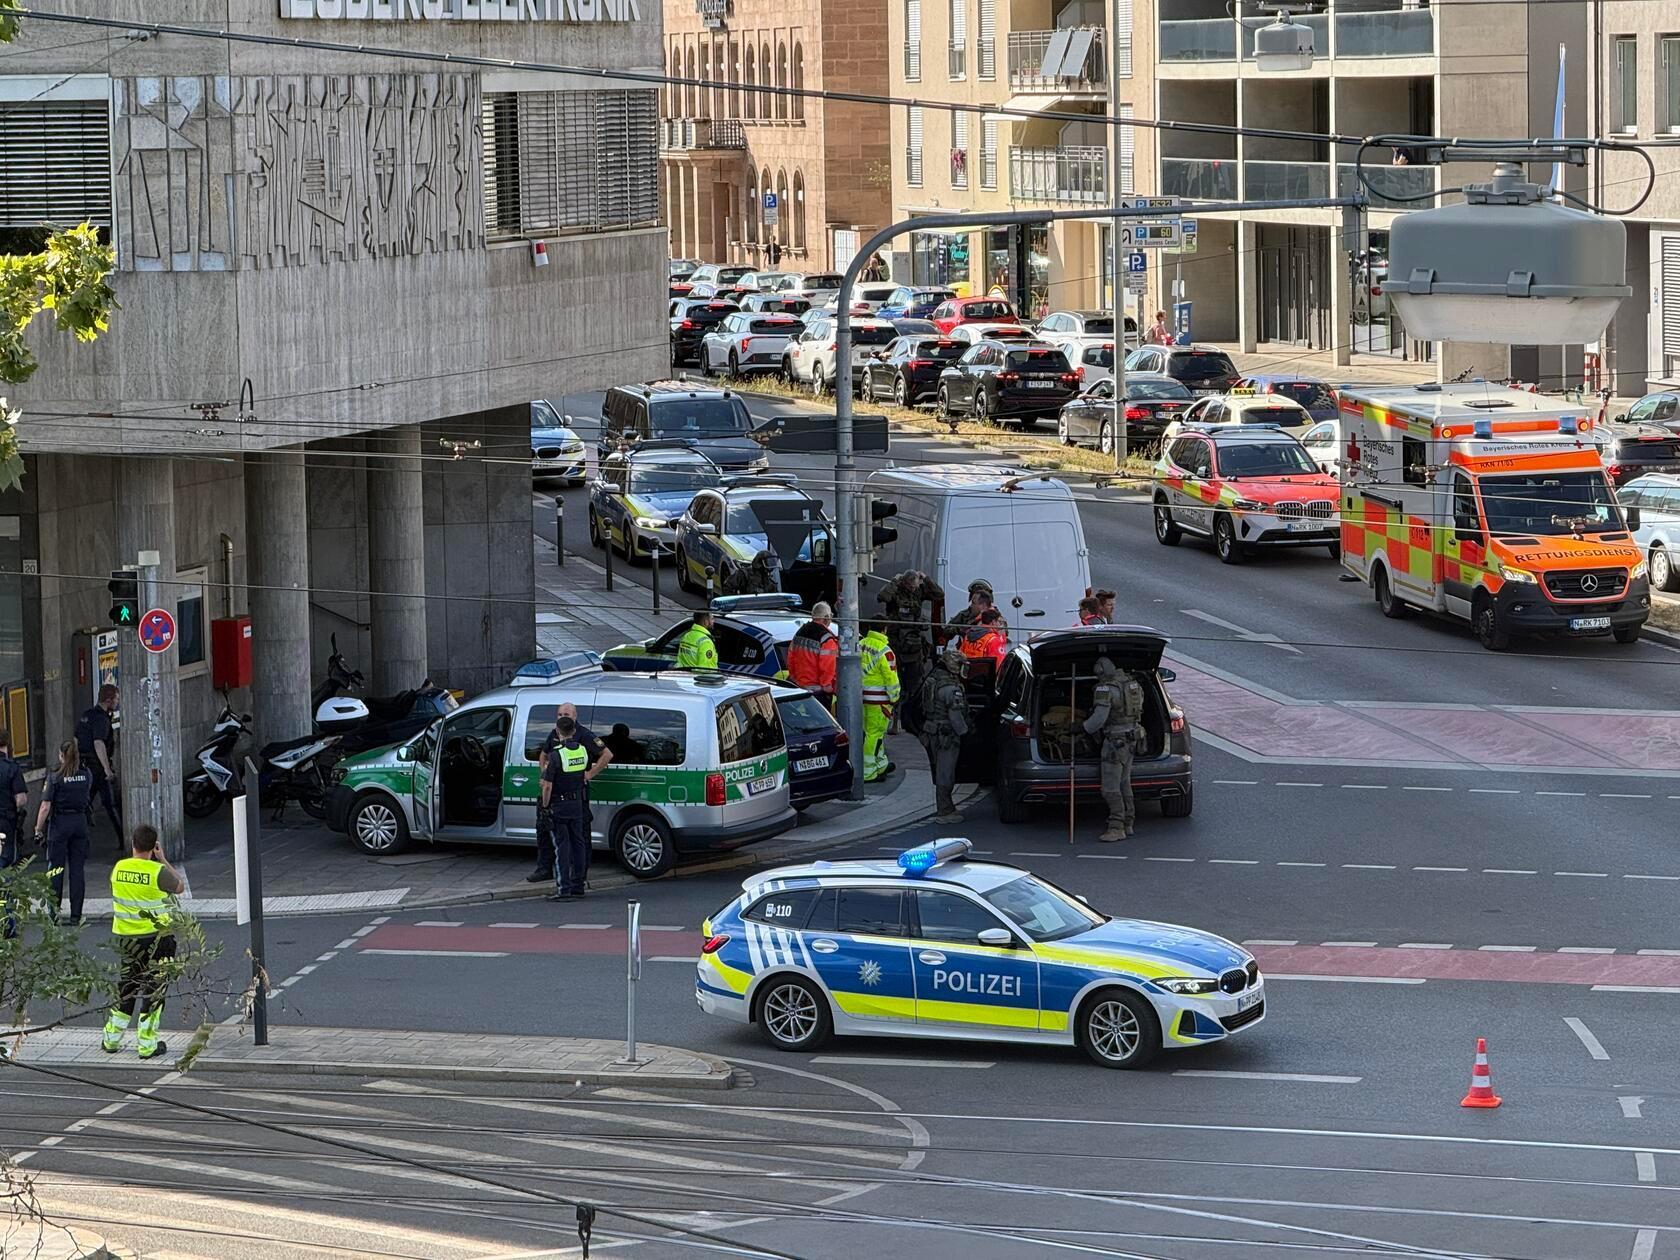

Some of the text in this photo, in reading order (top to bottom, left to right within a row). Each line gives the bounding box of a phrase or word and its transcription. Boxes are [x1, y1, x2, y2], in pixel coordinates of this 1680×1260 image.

[1161, 228, 1171, 238] 60
[1363, 435, 1394, 456] Bayerisches
[1483, 442, 1528, 452] Bayerisches
[1363, 450, 1379, 466] Rotes
[25, 564, 36, 574] 20
[1593, 617, 1610, 627] 7103
[63, 775, 87, 783] POLIZEI
[725, 766, 755, 782] POLIZEI
[775, 905, 792, 917] 110
[933, 969, 1021, 997] POLIZEI
